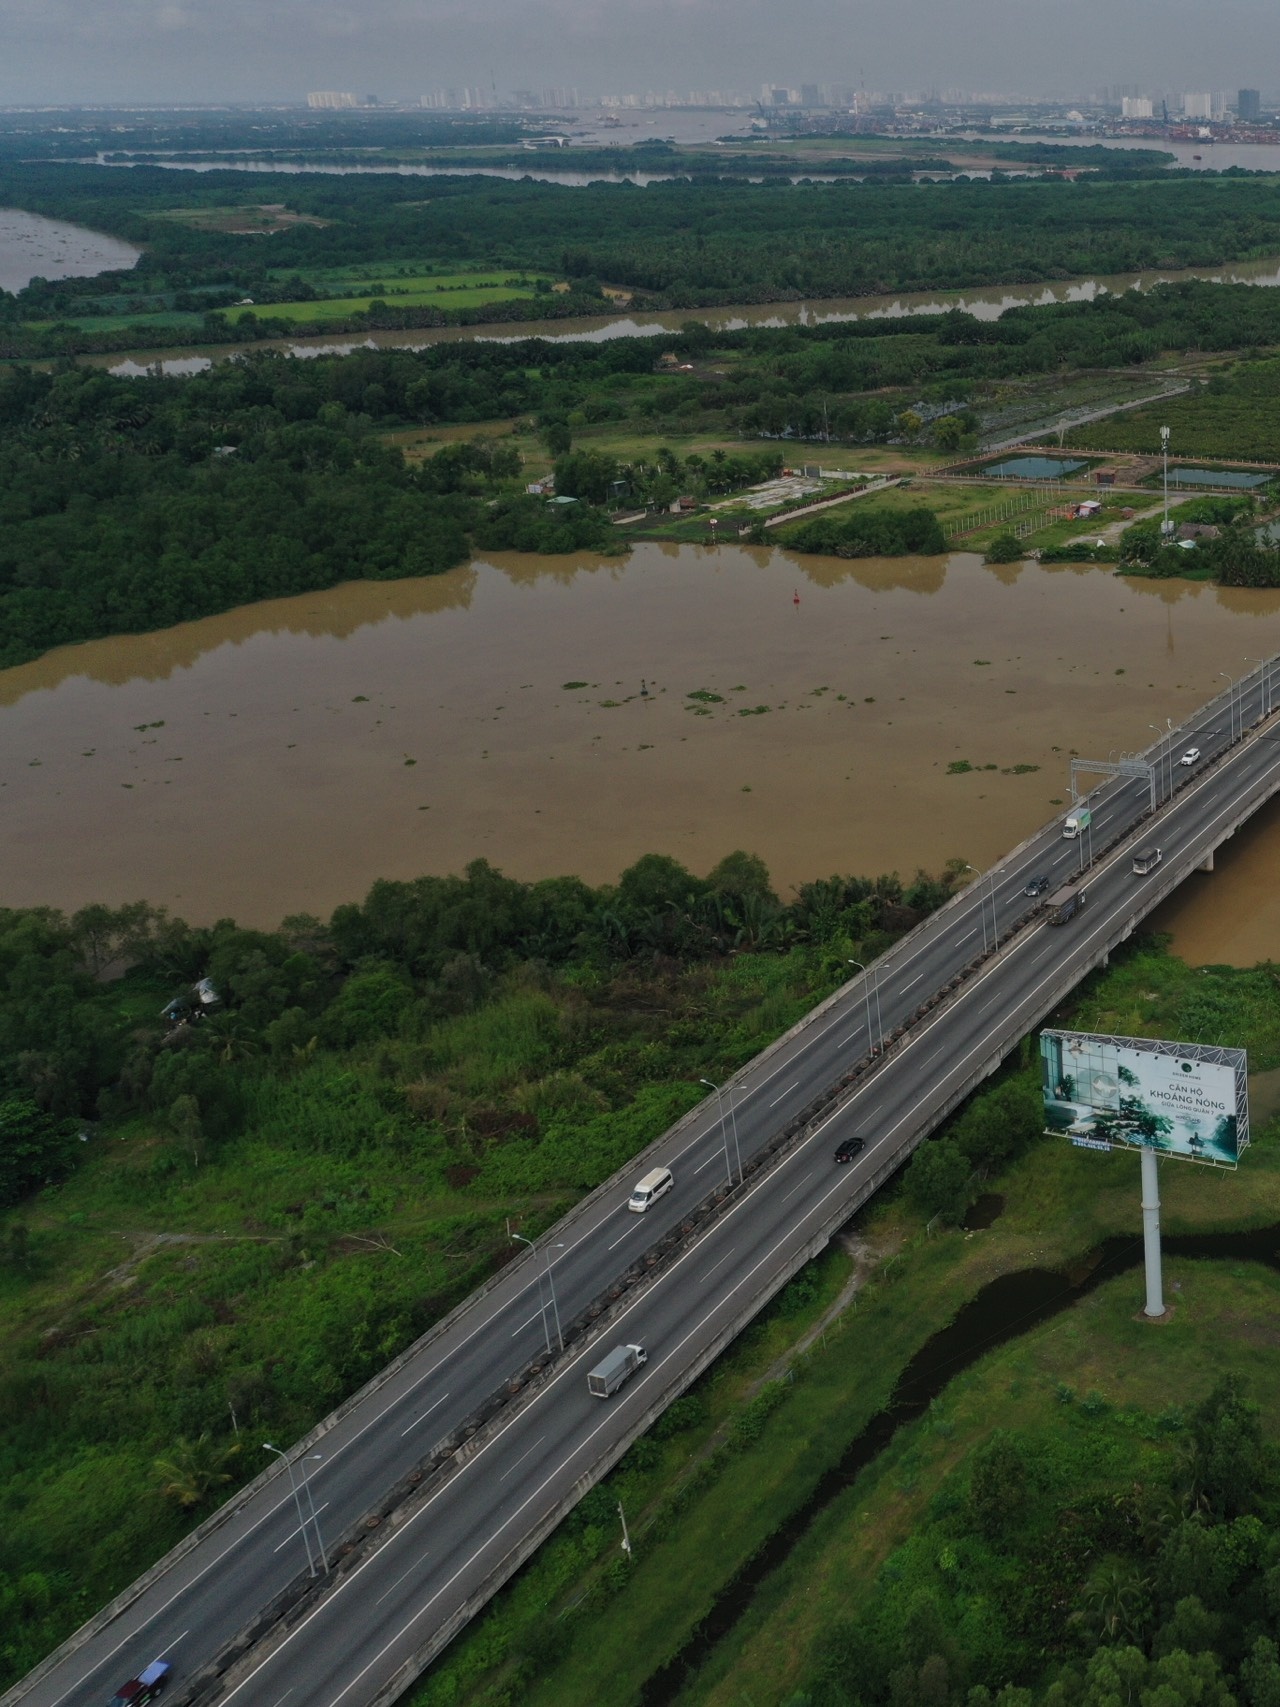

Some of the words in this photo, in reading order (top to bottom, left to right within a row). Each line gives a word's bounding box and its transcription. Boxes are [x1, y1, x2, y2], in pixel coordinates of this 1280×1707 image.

[1169, 1083, 1187, 1093] CĂN
[1190, 1088, 1203, 1097] HỘ
[1150, 1090, 1193, 1104] KHOÁNG
[1196, 1098, 1225, 1110] NÓNG
